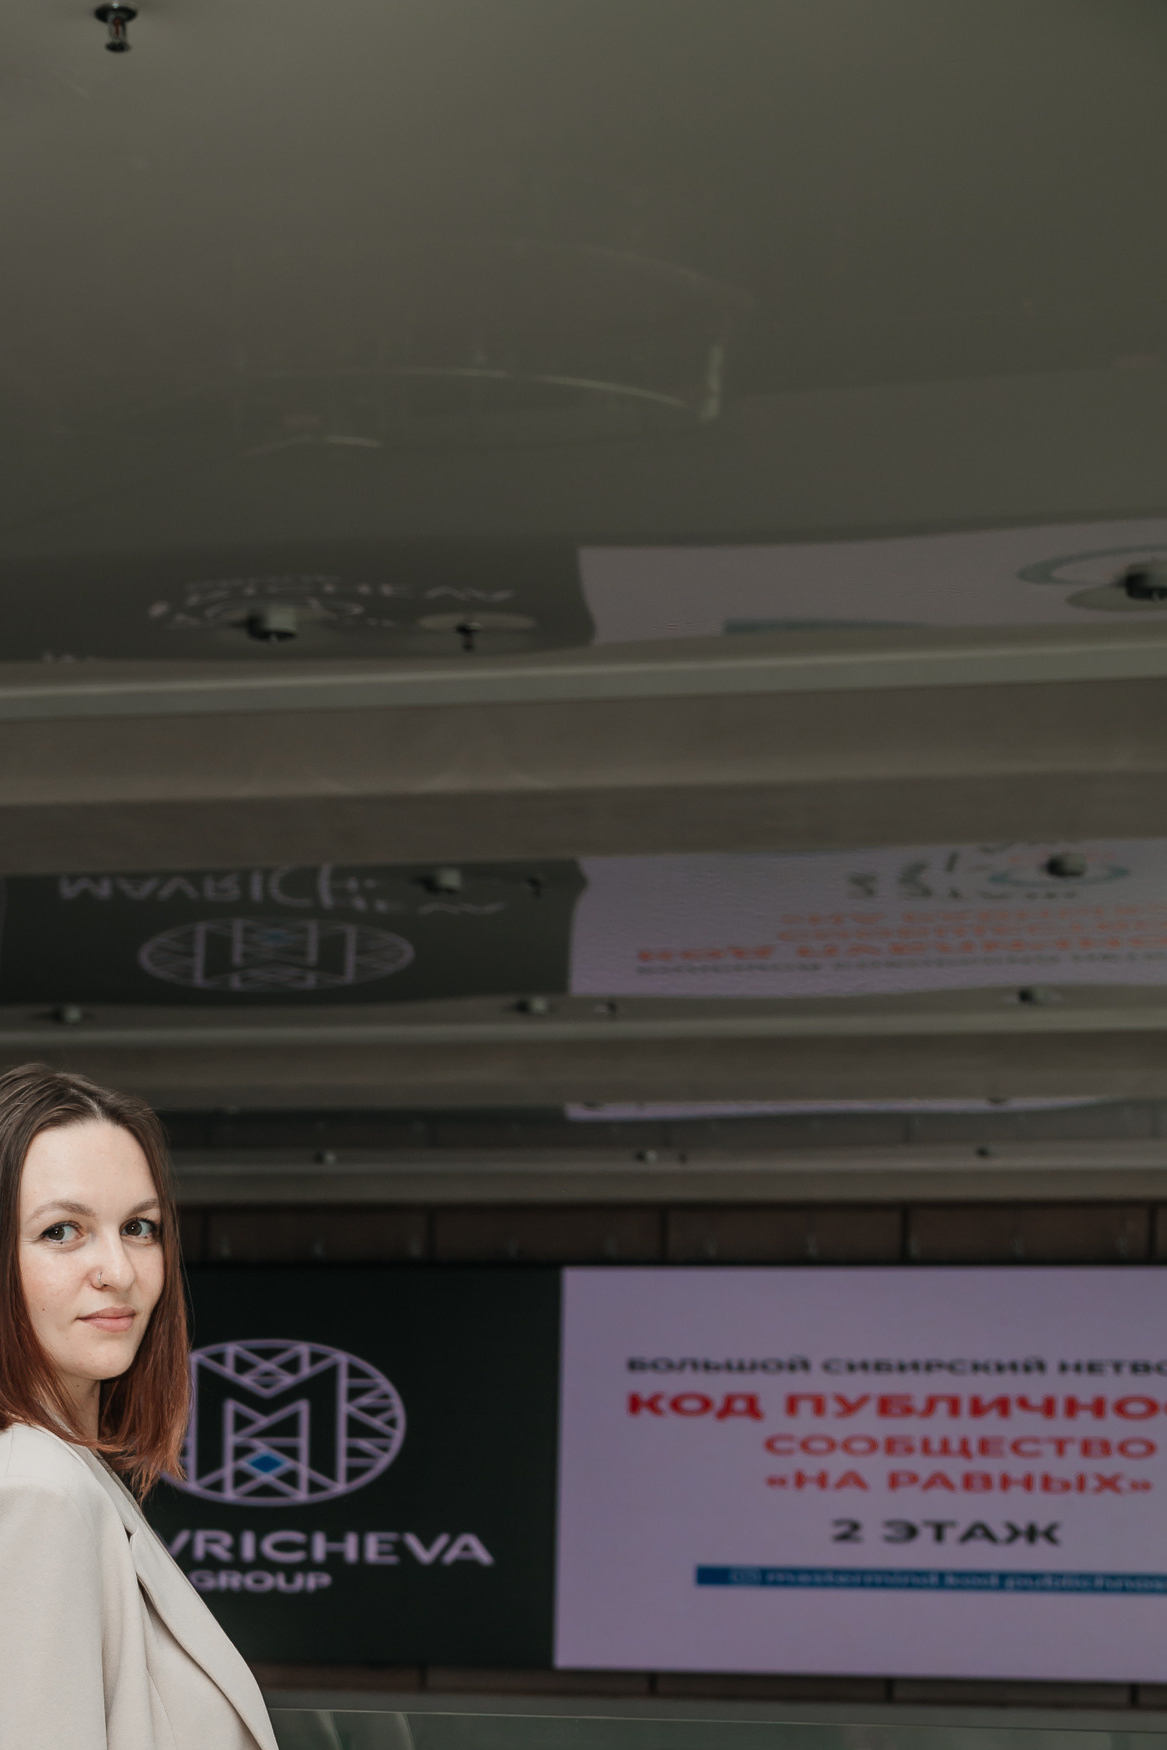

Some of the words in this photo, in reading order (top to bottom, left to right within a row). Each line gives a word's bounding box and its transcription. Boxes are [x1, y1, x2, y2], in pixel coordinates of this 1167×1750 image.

[627, 1354, 811, 1374] БОЛЬШОЙ
[822, 1355, 1046, 1376] СИБИРСКИЙ
[627, 1391, 764, 1421] КОД
[785, 1392, 1167, 1423] ПУБЛИЧНО
[765, 1434, 1157, 1461] СООБЩЕСТВО
[765, 1469, 871, 1493] «НА
[887, 1471, 1153, 1496] РАВНЫХ»
[832, 1519, 863, 1544] 2
[882, 1520, 1061, 1547] ЭТАЖ
[188, 1569, 333, 1593] GROUP
